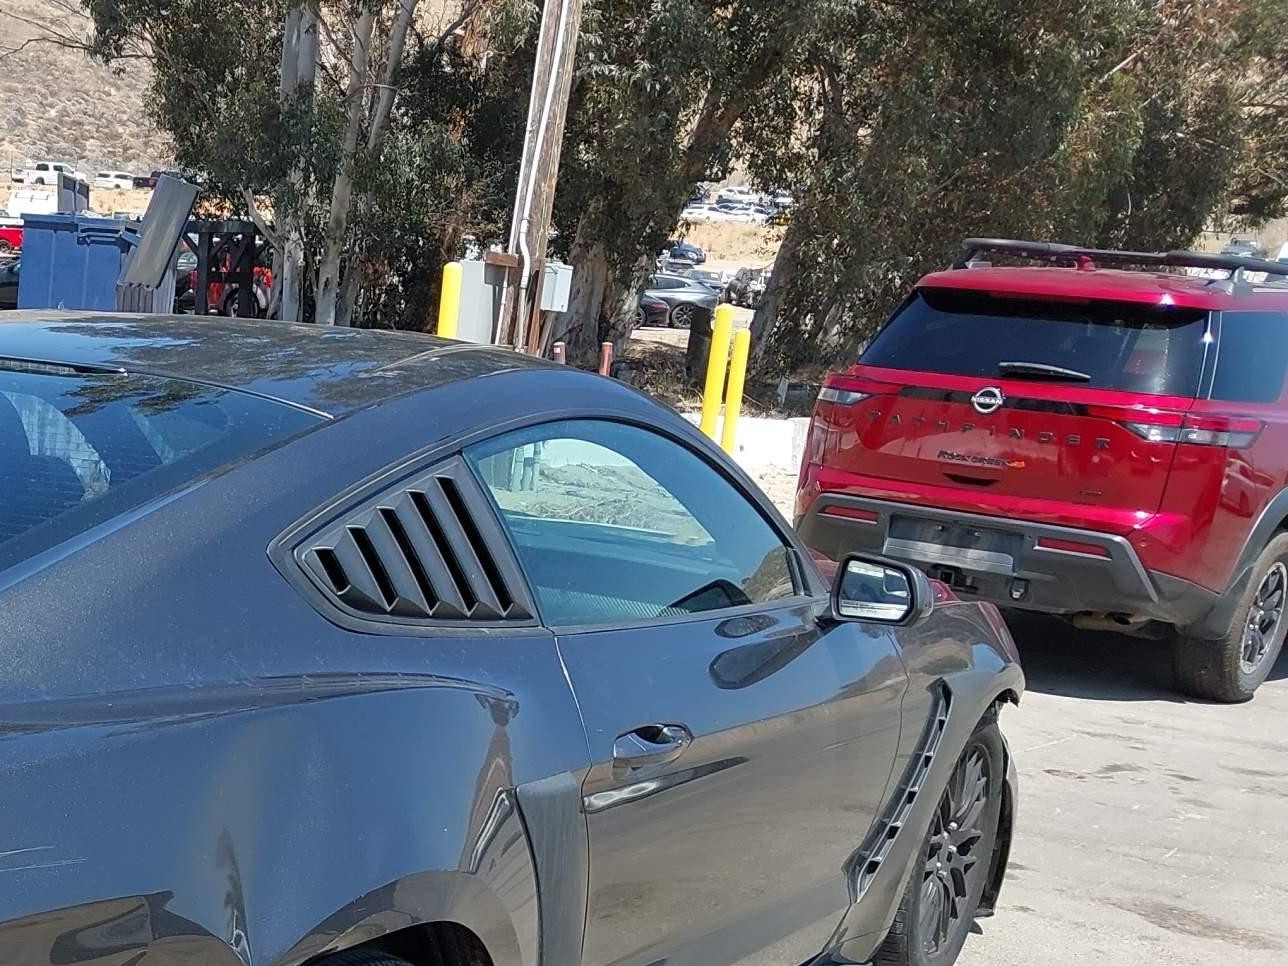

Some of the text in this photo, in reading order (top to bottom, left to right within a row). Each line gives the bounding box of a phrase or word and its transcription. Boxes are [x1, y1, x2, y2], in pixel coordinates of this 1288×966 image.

[971, 395, 1003, 406] NISSAN
[869, 409, 1111, 449] PATHFINDER
[937, 450, 970, 462] ROCK
